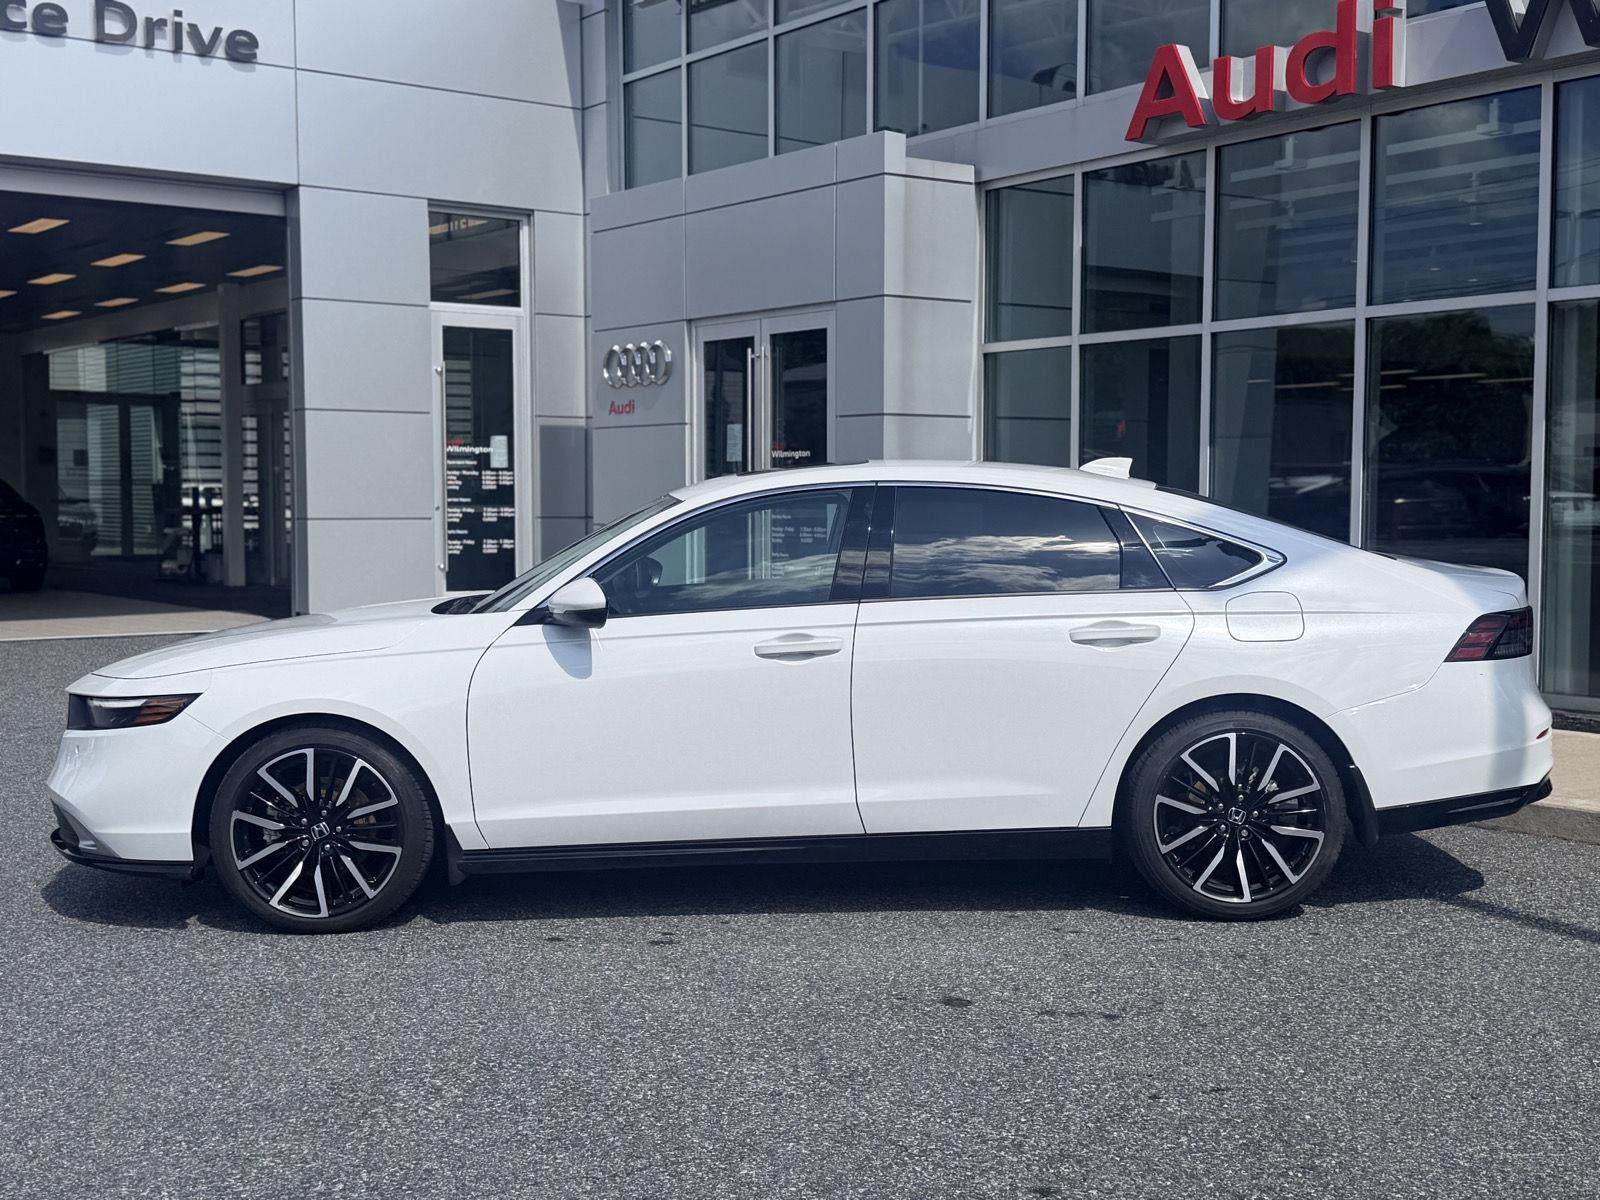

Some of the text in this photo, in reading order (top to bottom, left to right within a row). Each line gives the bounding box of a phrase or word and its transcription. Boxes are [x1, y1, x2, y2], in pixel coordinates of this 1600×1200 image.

[95, 0, 259, 61] Drive
[1124, 0, 1396, 141] Audi
[608, 399, 635, 416] Audi
[446, 445, 494, 454] Wilmington
[771, 450, 811, 459] Wilmington
